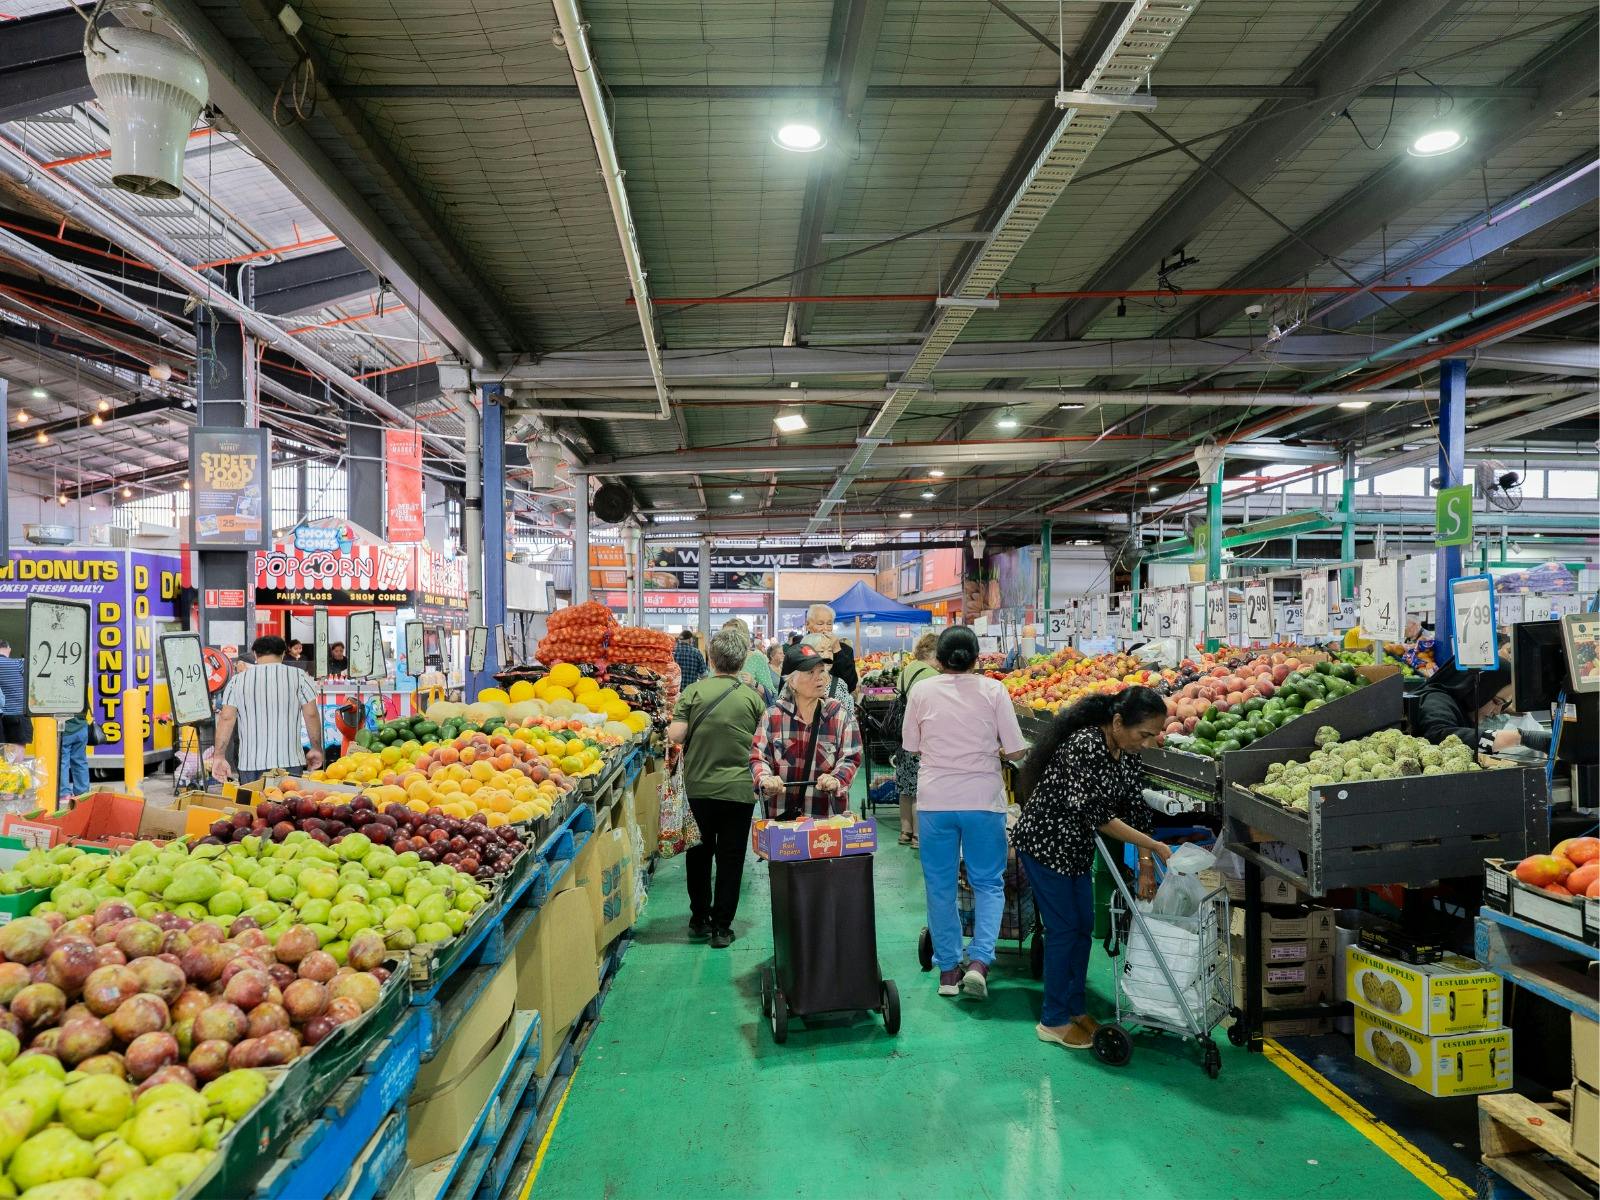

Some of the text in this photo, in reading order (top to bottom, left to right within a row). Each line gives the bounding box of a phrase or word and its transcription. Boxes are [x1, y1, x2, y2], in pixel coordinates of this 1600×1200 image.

[201, 452, 257, 471] STREET
[204, 465, 253, 482] FOOD
[1447, 496, 1461, 535] S
[299, 527, 336, 539] SNOW
[299, 539, 337, 549] CONES
[254, 552, 374, 579] POPCORN
[678, 550, 800, 565] WELCOME
[19, 559, 119, 580] DONUTS
[30, 584, 66, 593] FRESH
[69, 585, 104, 594] DAILY!
[276, 592, 408, 601] FAIRY FLOSS SNOW CONES
[1247, 595, 1267, 624] 299
[1458, 604, 1491, 644] 799
[98, 602, 122, 742] DONUTS
[780, 849, 801, 857] Papaya
[1352, 952, 1415, 982] CUSTARD APPLES
[1434, 976, 1497, 987] CUSTARD APPLES
[1361, 1010, 1424, 1045] CUSTARD APPLES
[1443, 1036, 1505, 1048] CUSTARD APPLES
